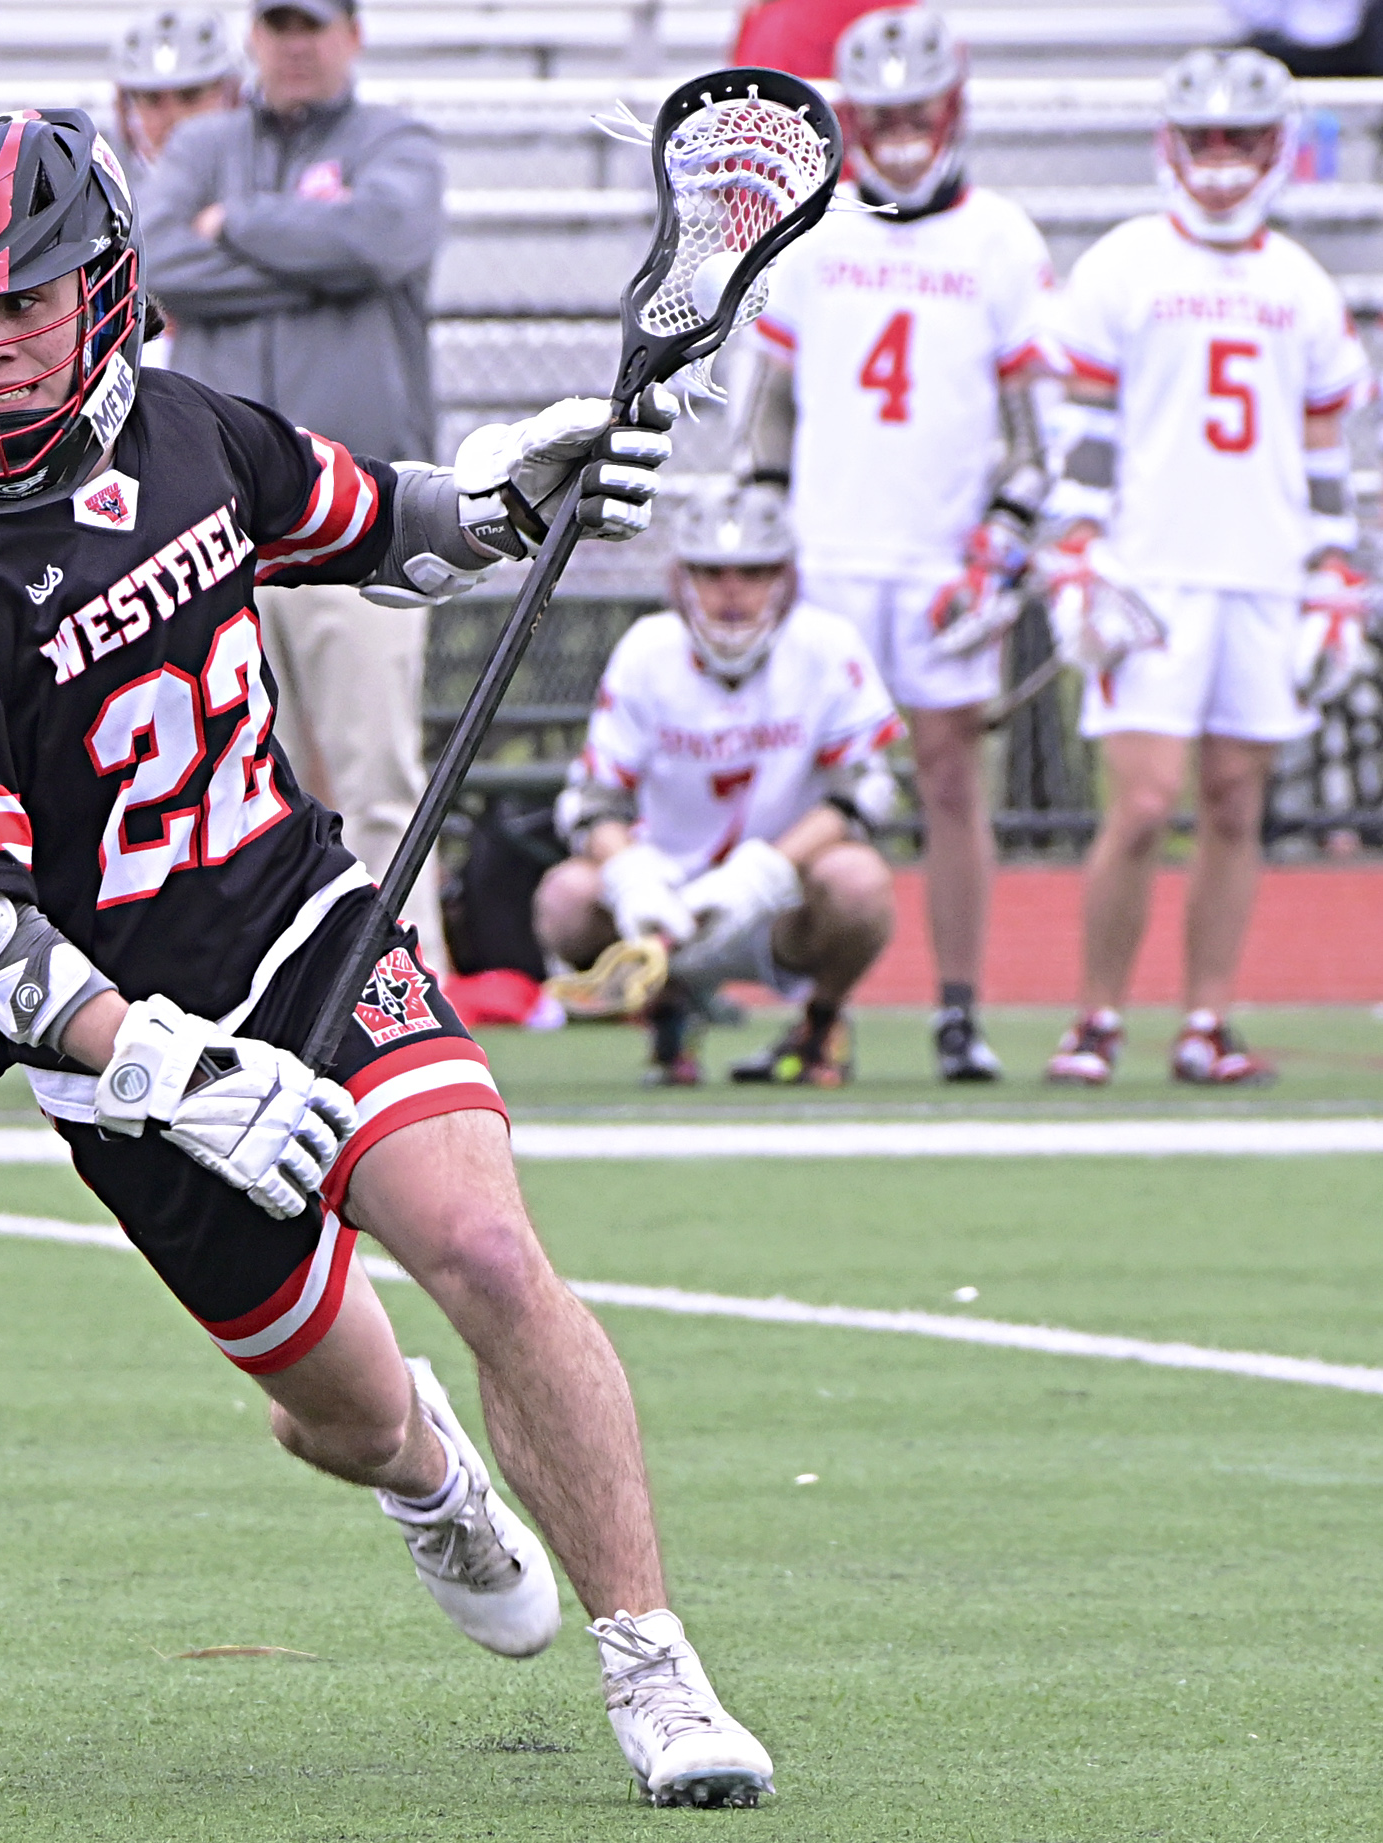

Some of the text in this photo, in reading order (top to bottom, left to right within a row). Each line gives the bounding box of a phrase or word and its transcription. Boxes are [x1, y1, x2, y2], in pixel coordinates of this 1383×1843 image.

[859, 310, 912, 423] 4
[1205, 340, 1260, 453] 5
[39, 496, 255, 685] WESTFIEL
[83, 606, 293, 910] 22
[707, 764, 756, 867] 7
[373, 1018, 438, 1045] LACROSSE
